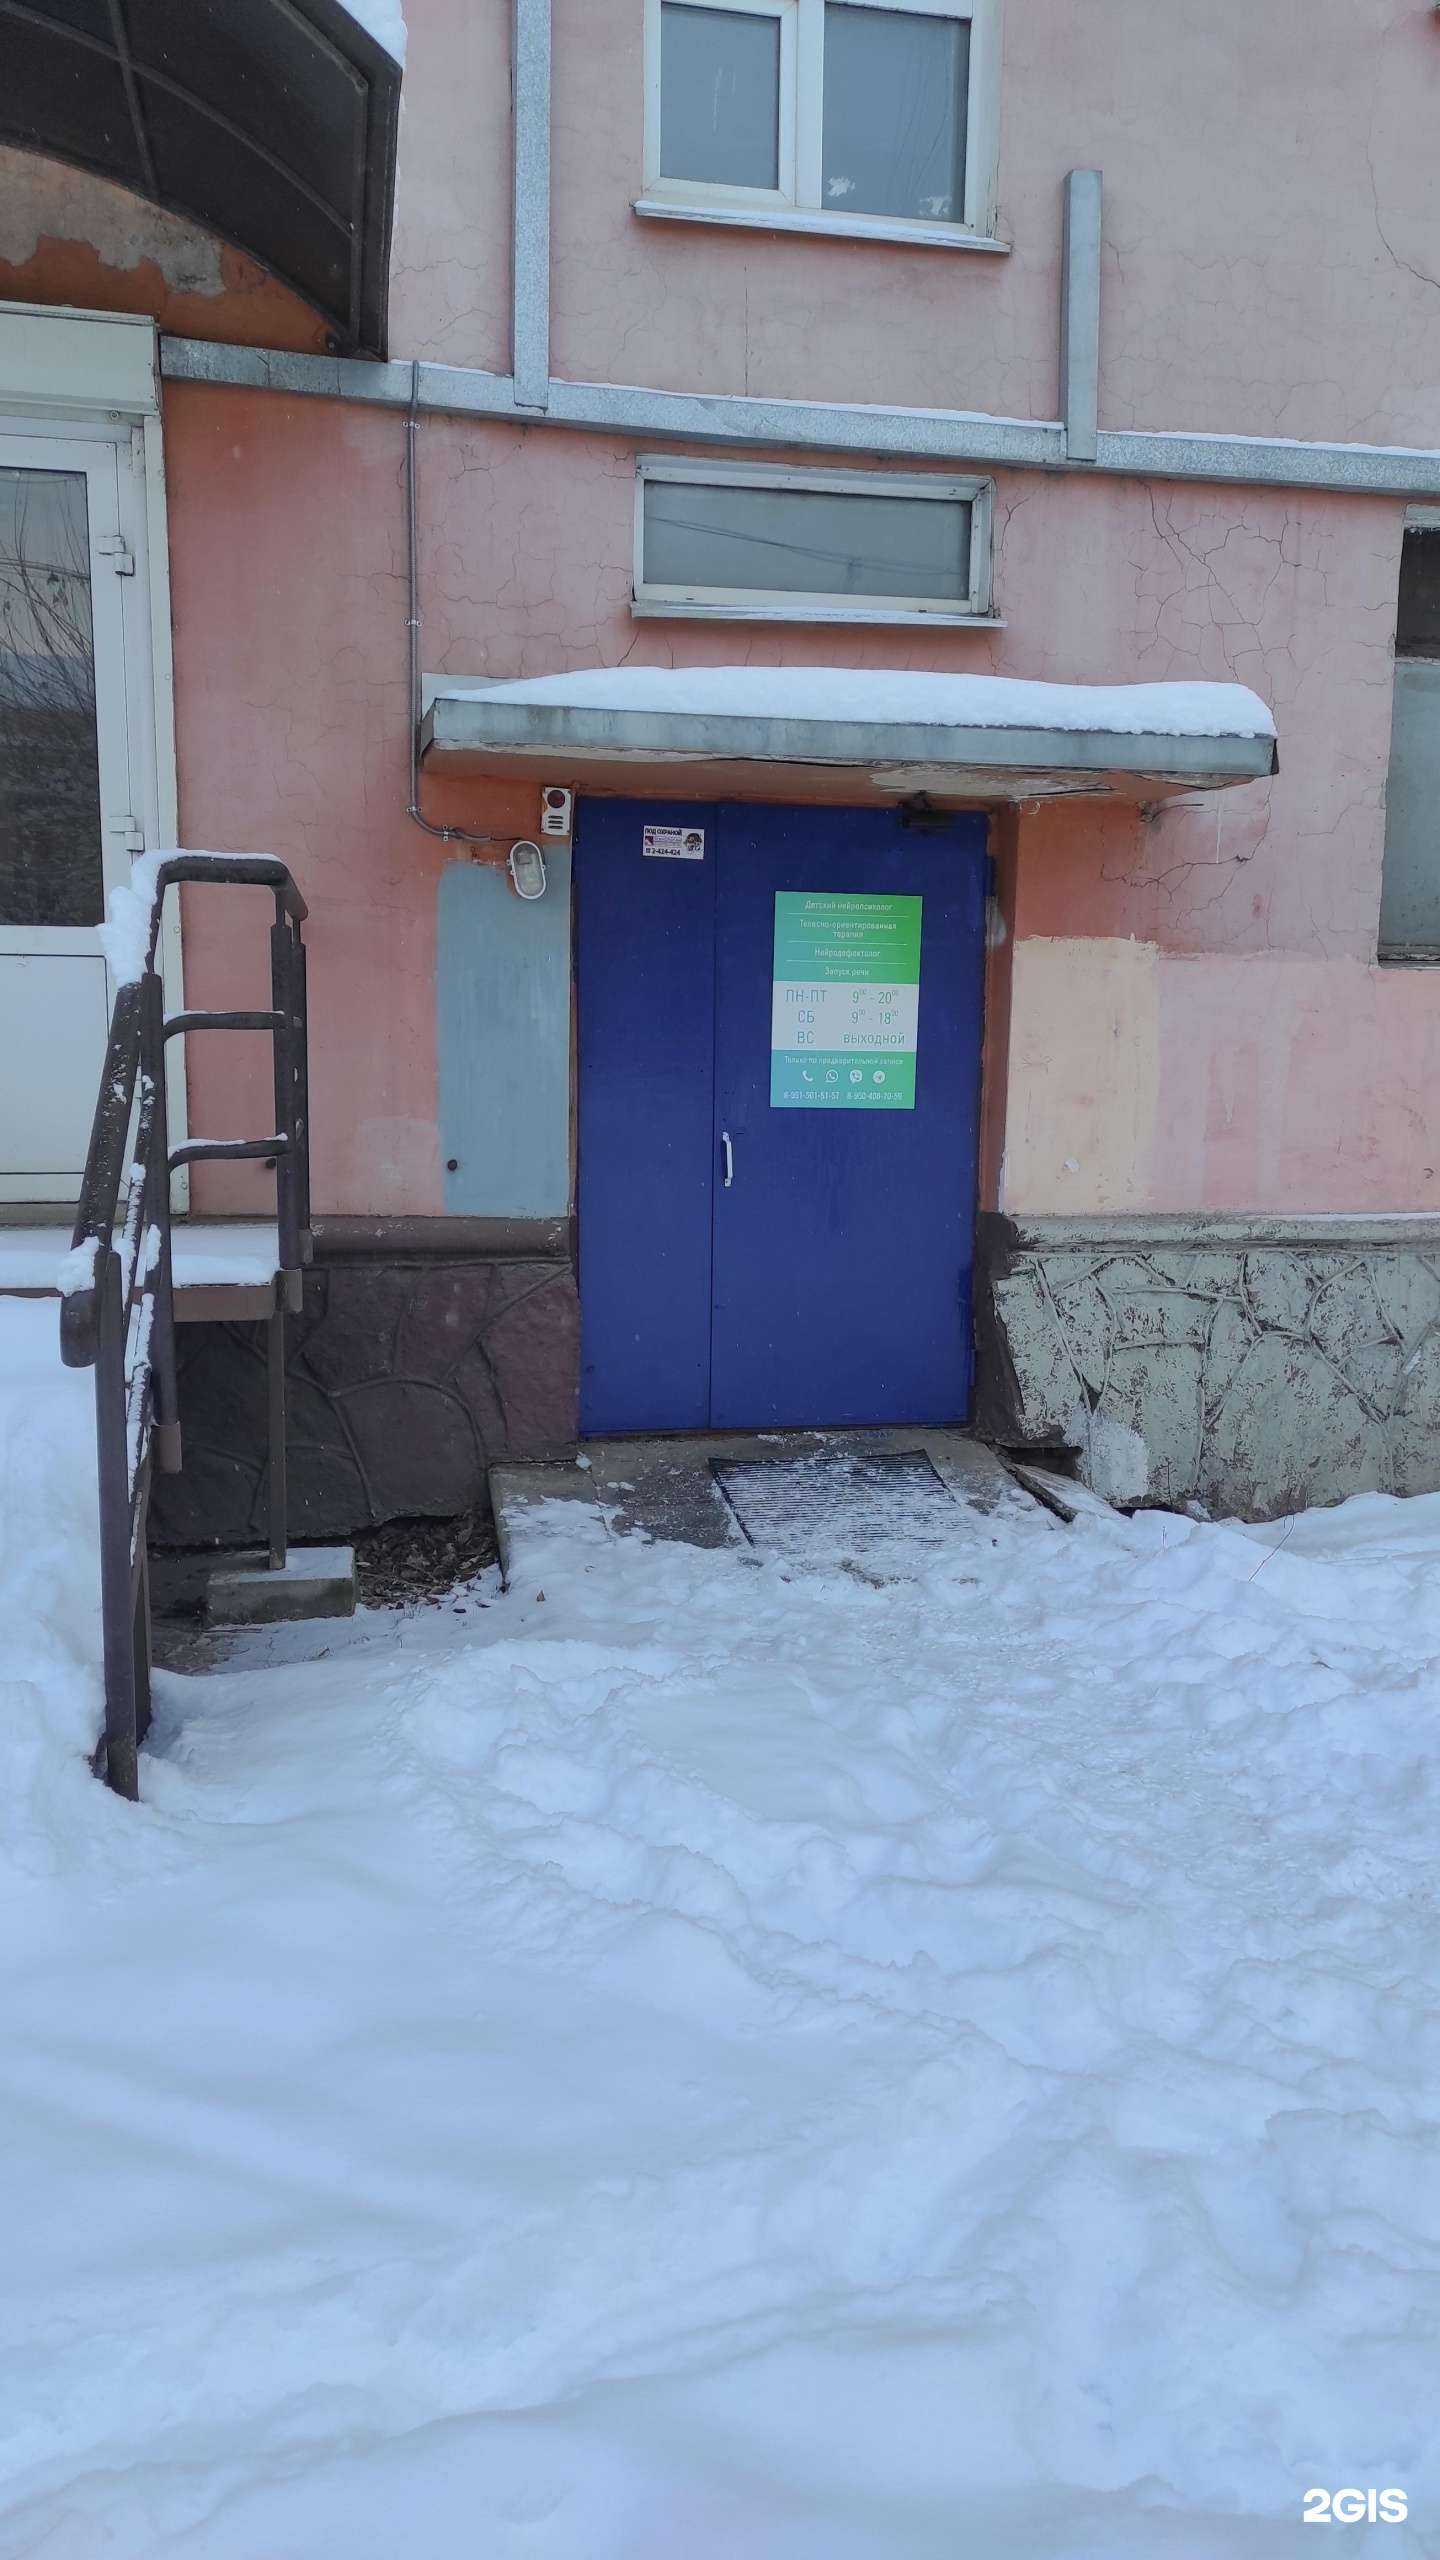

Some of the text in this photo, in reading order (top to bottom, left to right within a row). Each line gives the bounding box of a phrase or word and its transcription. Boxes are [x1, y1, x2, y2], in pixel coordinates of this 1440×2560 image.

[804, 900, 892, 912] Детский нейропсихолог
[800, 919, 897, 931] Телесно-ориентированная
[832, 931, 864, 939] терапия
[814, 947, 881, 958] Нейродефектолог
[824, 967, 870, 977] Запуск речи
[785, 989, 827, 1003] ПН-ПТ
[797, 1010, 815, 1024] СБ
[797, 1031, 815, 1044] ВС
